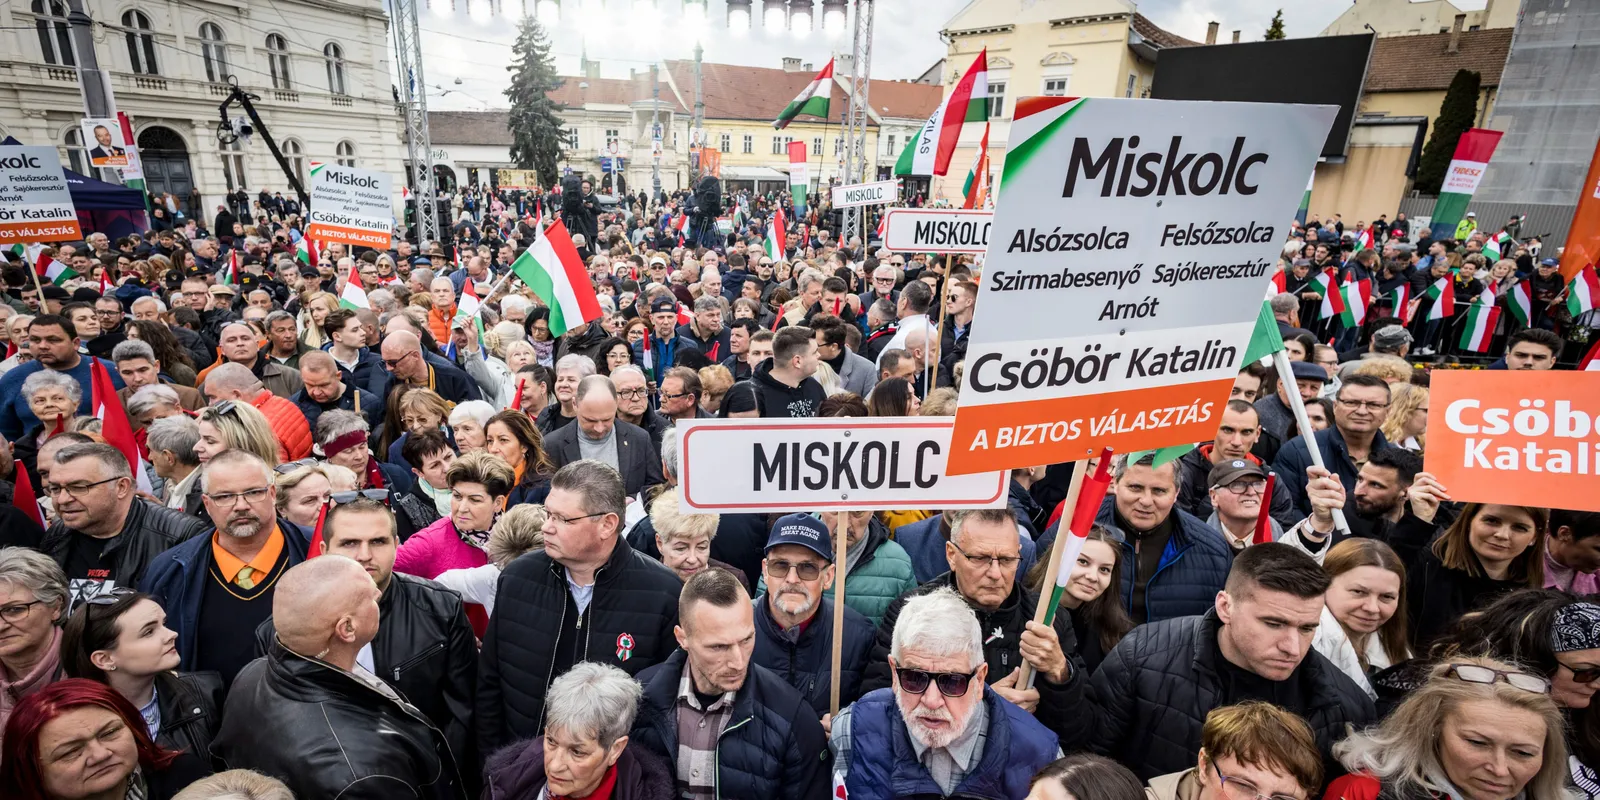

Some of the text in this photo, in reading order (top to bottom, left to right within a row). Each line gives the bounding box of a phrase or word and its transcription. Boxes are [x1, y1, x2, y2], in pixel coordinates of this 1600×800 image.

[1062, 135, 1269, 198] Miskolc
[9, 174, 59, 183] Felsőzsolca
[326, 170, 379, 190] Miskolc
[13, 184, 65, 193] Sajókeresztúr
[315, 185, 346, 195] Alsózsolca
[845, 187, 883, 203] MISKOLC
[21, 208, 72, 219] Katalin
[312, 211, 389, 230] Csöbör Katalin
[16, 225, 75, 237] VÁLASZTÁS
[322, 230, 347, 239] BIZTOS
[348, 231, 387, 244] VÁLASZTÁS
[1007, 221, 1274, 253] Alsózsolca Felsőzsolca
[990, 257, 1270, 292] Szirmabesenyő Sajókeresztúr
[1098, 296, 1159, 321] Arnót
[969, 339, 1237, 393] Csöbör Katalin
[969, 398, 1214, 451] A BIZTOS VÁLASZTÁS
[1444, 398, 1600, 438] Csöb
[752, 440, 941, 492] MISKOLC
[798, 525, 820, 536] EUROPE
[800, 531, 818, 540] AGAIN
